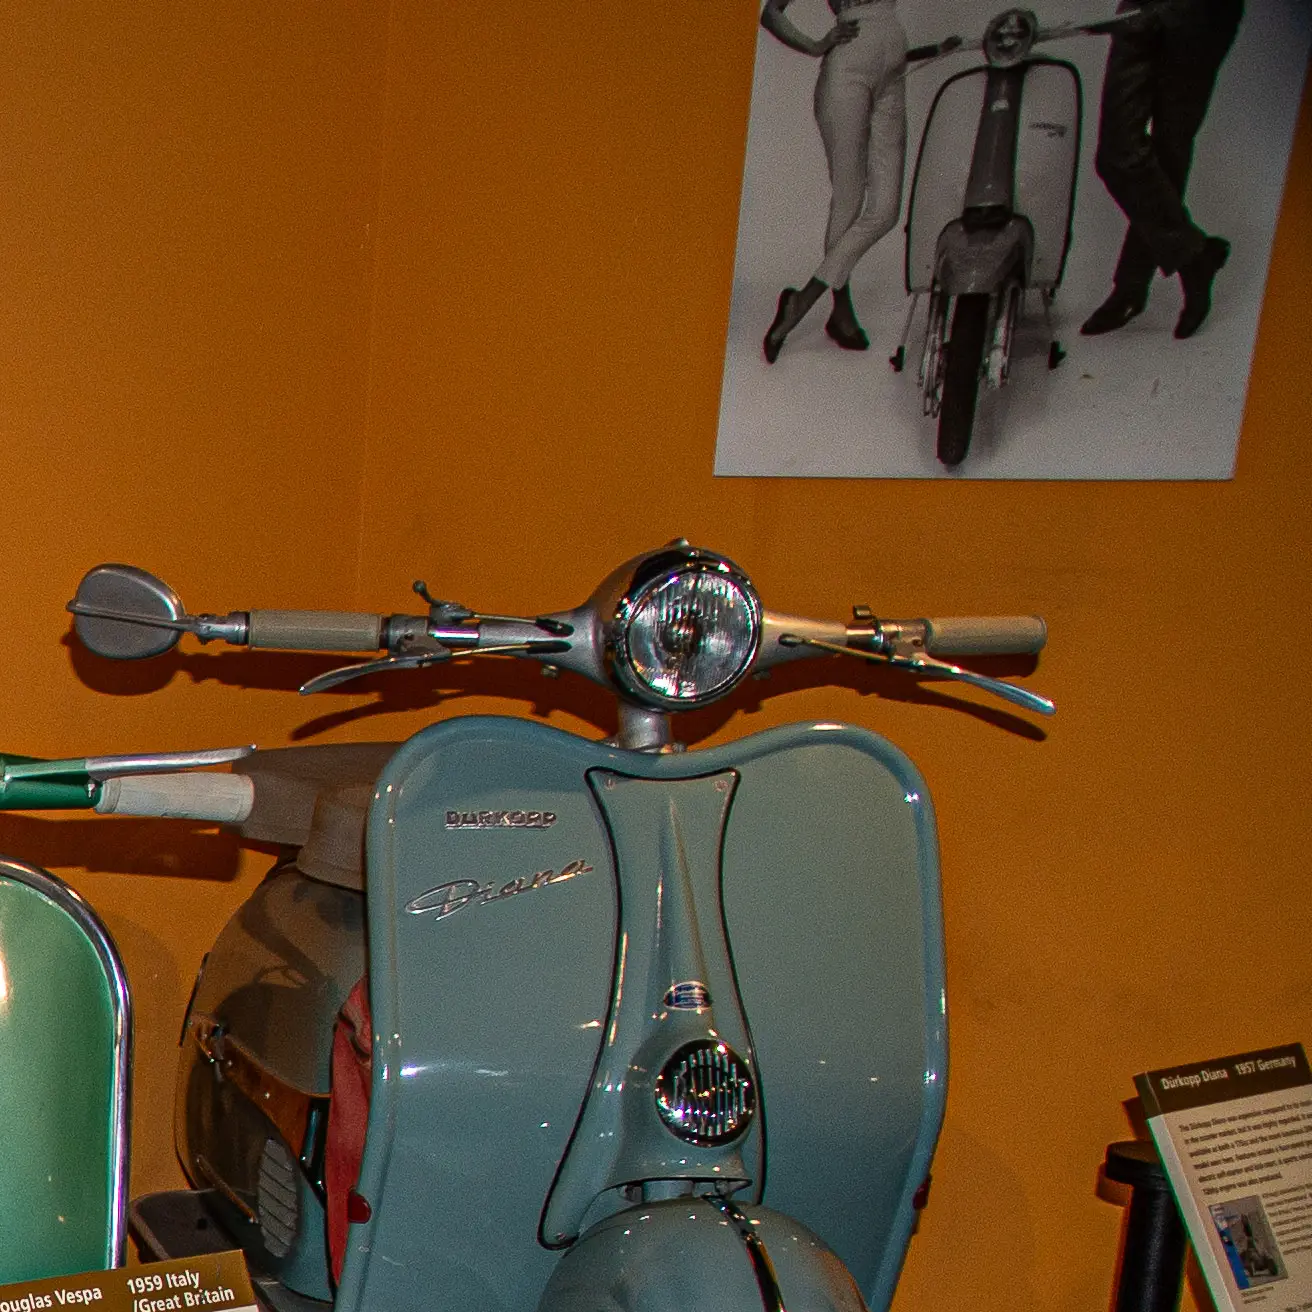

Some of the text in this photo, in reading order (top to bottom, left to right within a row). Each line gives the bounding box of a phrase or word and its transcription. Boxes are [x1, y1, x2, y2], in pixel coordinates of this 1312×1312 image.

[404, 858, 594, 922] Diana
[1201, 1068, 1229, 1083] Diana
[1257, 1056, 1297, 1072] Germany
[126, 1269, 199, 1294] 1959 Italy
[53, 1287, 102, 1304] Vespa
[183, 1285, 234, 1306] Britain
